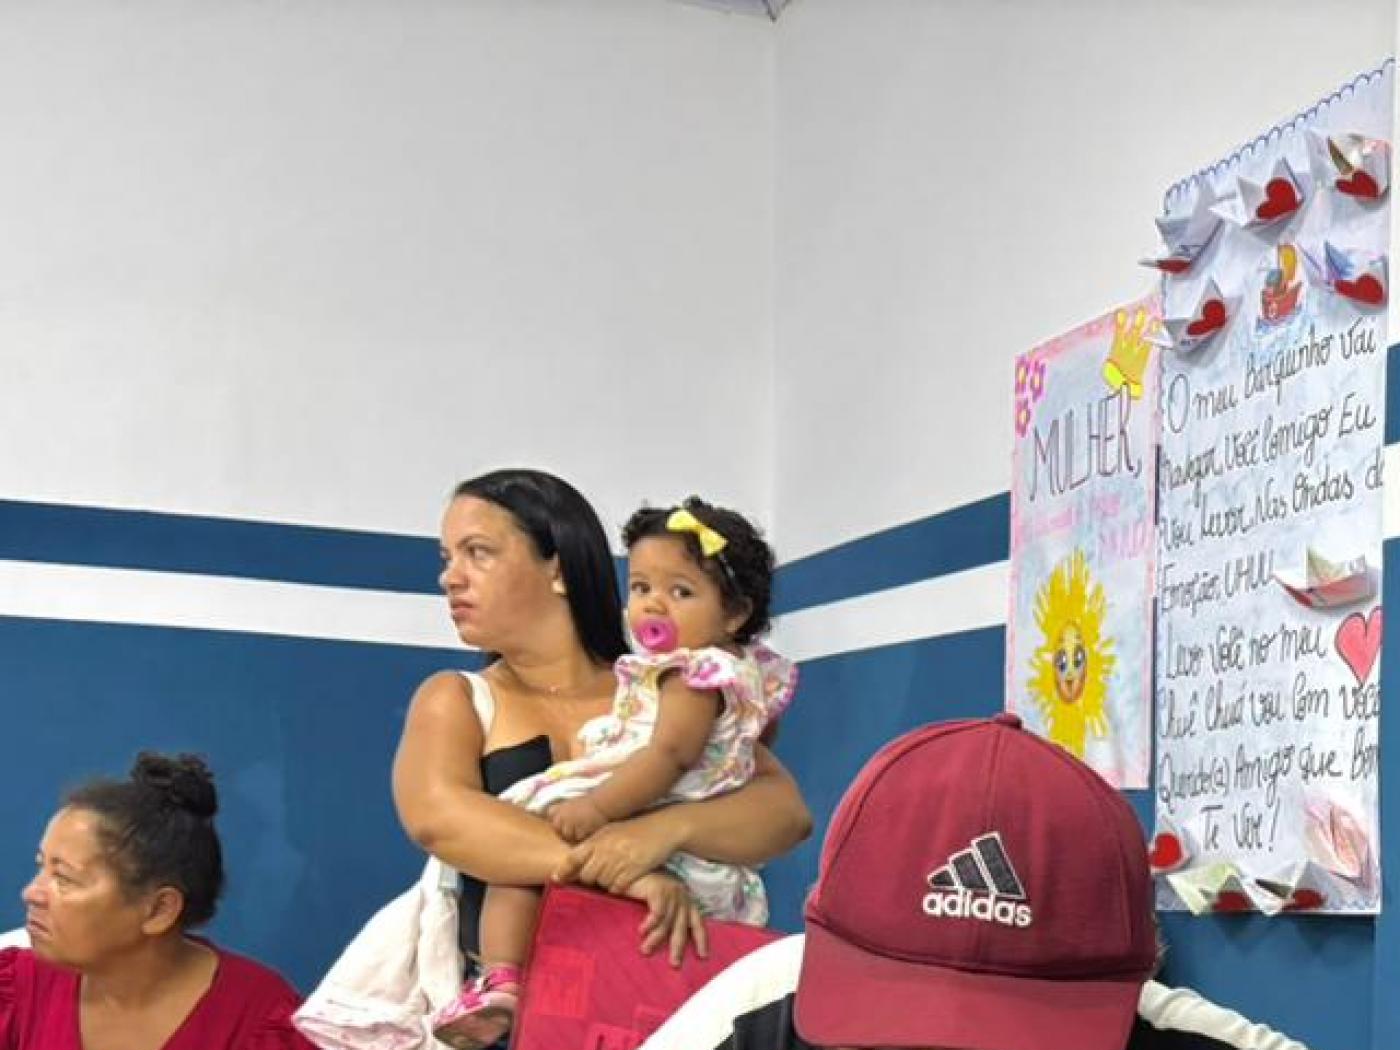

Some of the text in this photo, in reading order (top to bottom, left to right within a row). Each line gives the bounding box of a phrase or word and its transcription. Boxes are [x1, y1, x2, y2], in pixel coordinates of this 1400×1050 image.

[1168, 373, 1190, 434] O
[1192, 383, 1239, 420] meu
[1339, 392, 1377, 438] Eu
[1200, 804, 1224, 850] Te
[922, 890, 1032, 927] adidas
